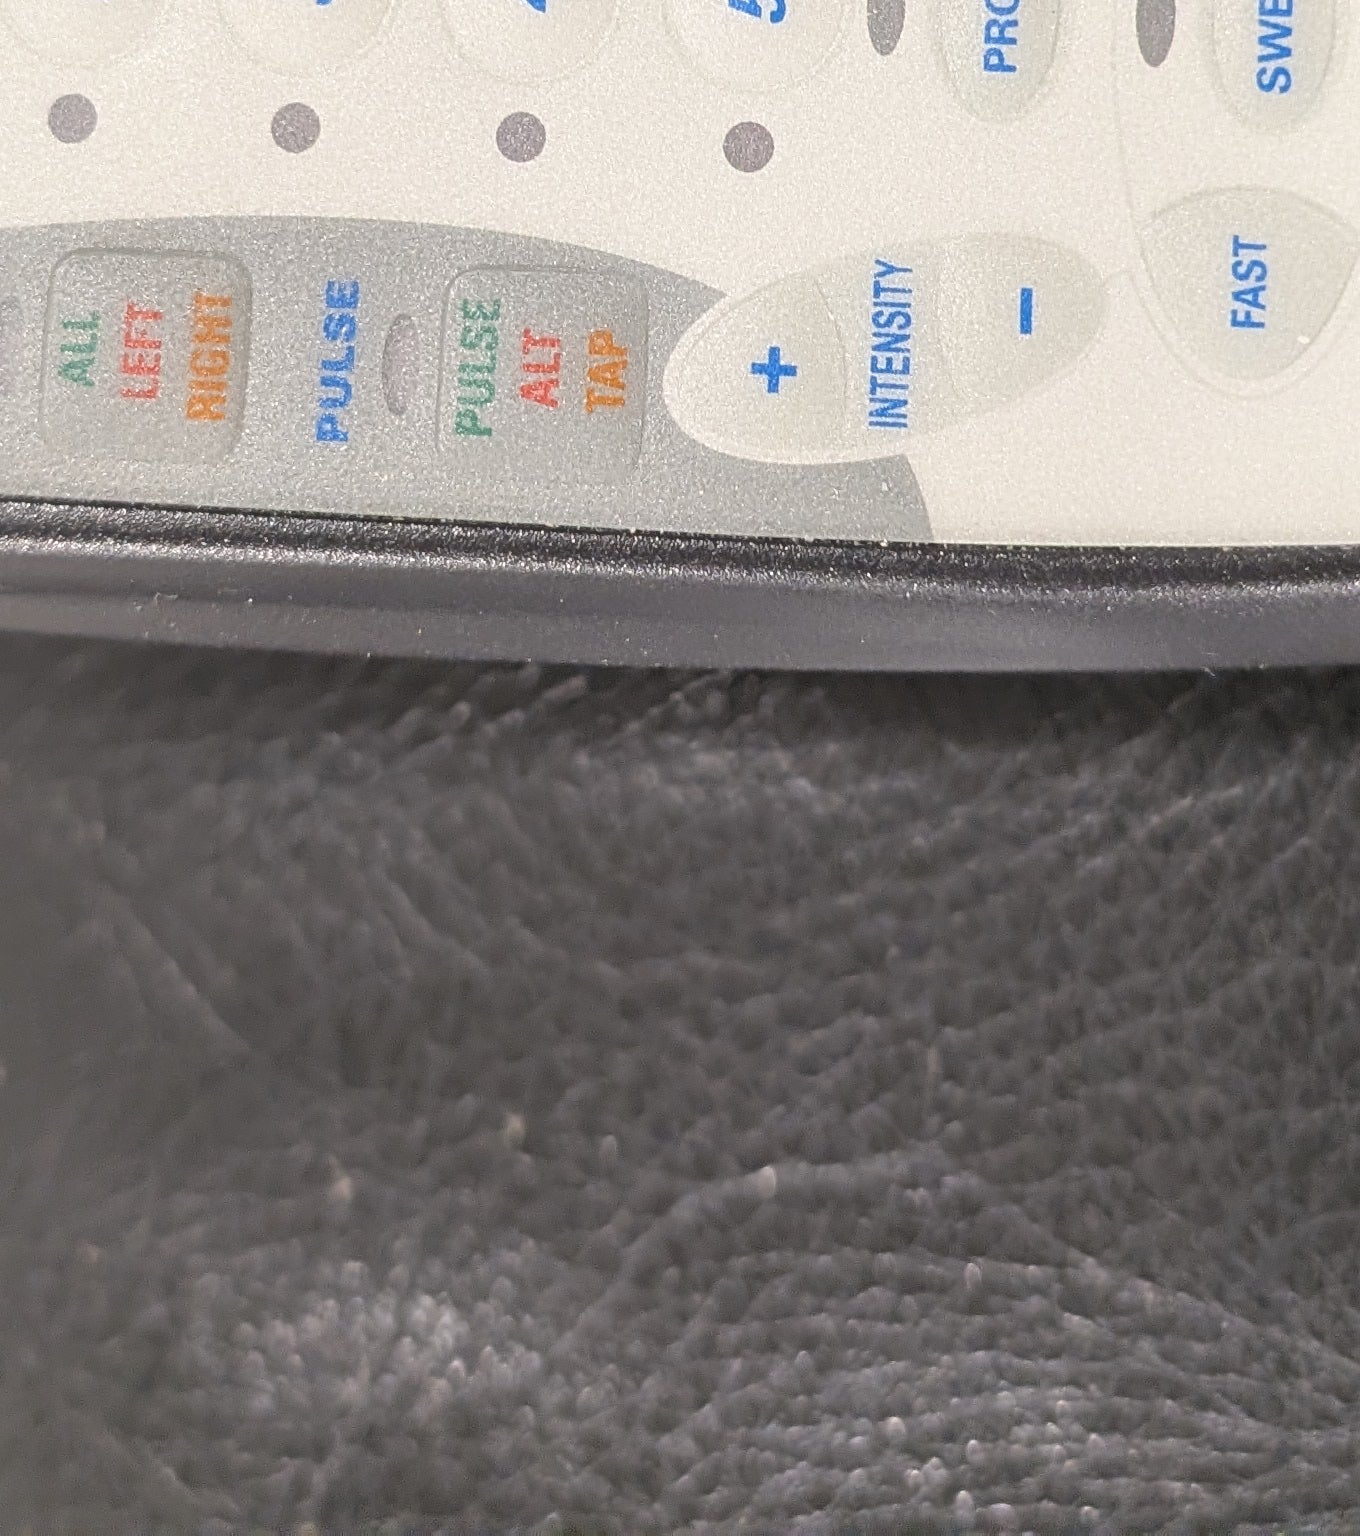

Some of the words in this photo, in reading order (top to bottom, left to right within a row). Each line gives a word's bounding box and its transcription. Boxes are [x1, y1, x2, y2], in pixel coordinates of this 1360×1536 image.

[1231, 236, 1270, 330] FAST
[58, 311, 100, 387] ALL
[120, 300, 162, 399] LEFT
[186, 291, 232, 420] RIGHT
[316, 280, 360, 442] PULSE
[455, 298, 500, 437] PULSE
[520, 328, 562, 408] ALT
[586, 330, 629, 413] TAP
[869, 260, 914, 429] INTENSITY
